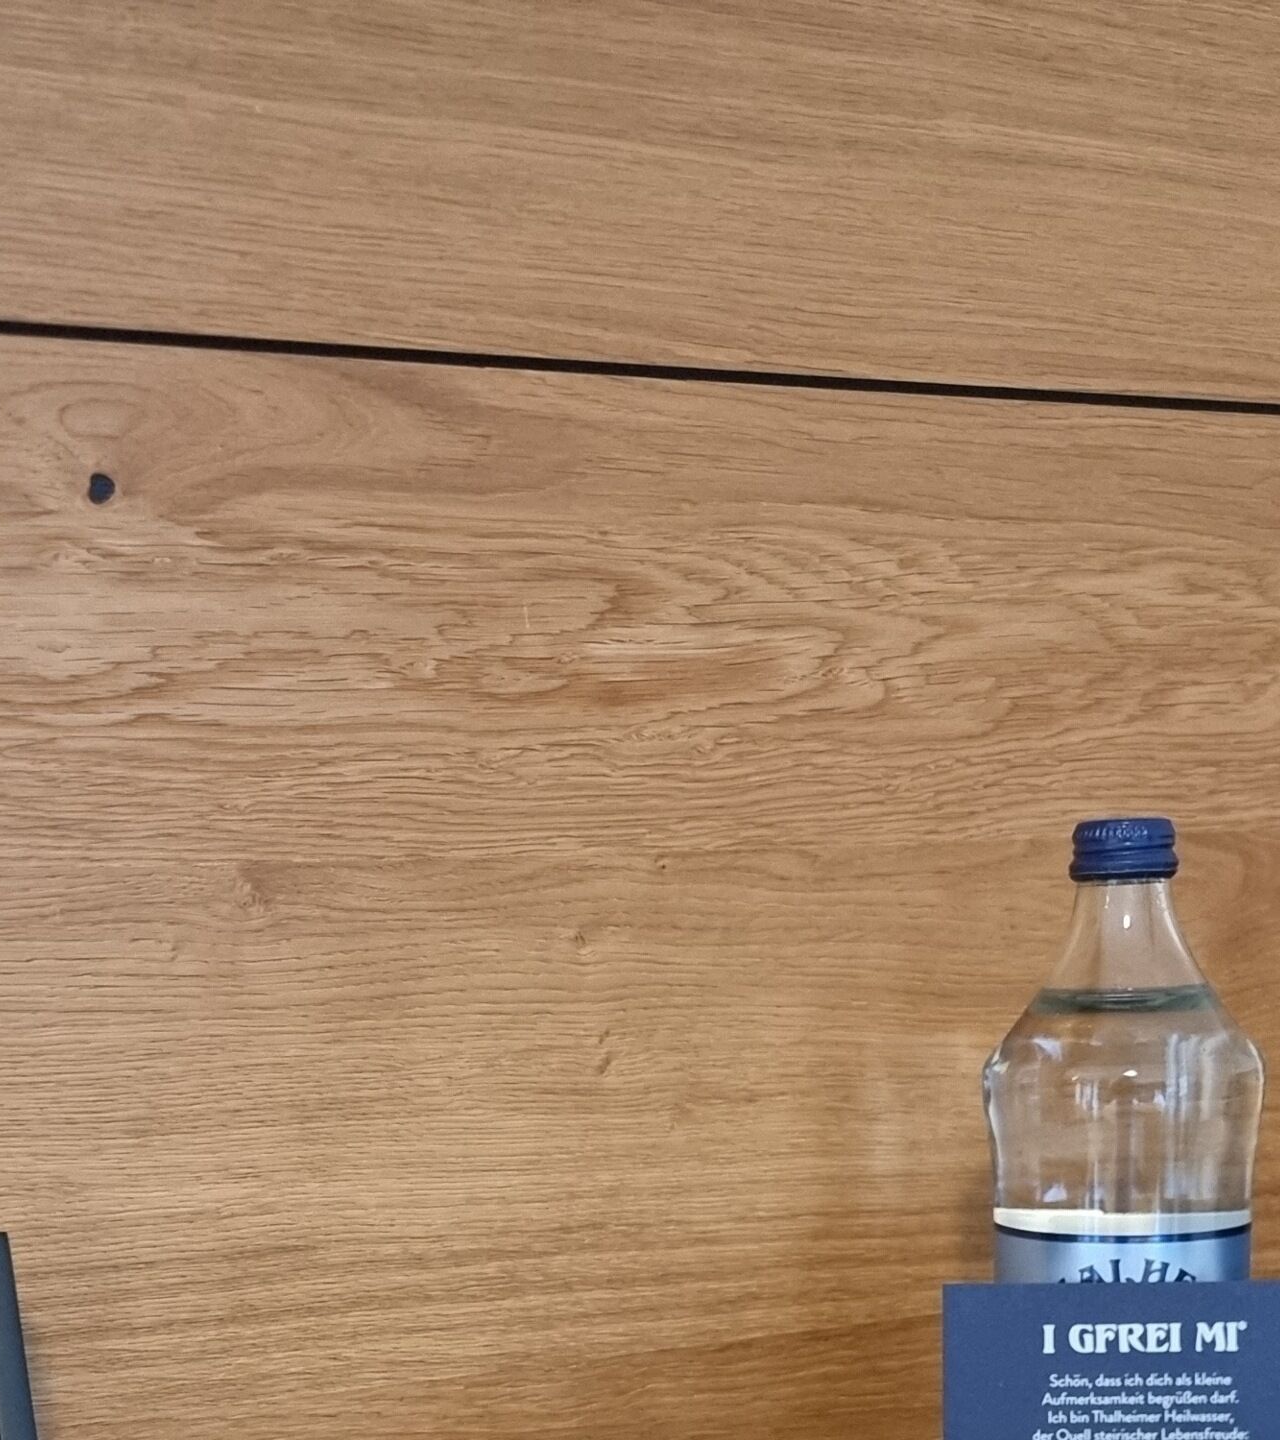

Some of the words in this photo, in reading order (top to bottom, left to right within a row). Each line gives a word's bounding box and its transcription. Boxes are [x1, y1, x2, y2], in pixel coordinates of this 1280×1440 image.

[1042, 1324, 1055, 1354] I
[1069, 1322, 1182, 1353] GFREI
[1049, 1373, 1093, 1389] Schön,
[1095, 1373, 1122, 1387] dass
[1124, 1373, 1143, 1387] ich
[1145, 1373, 1173, 1387] dich
[1175, 1372, 1192, 1386] als
[1194, 1372, 1233, 1386] kleine
[1042, 1390, 1145, 1406] Aufmerksamkeit
[1147, 1390, 1207, 1409] begrüßen
[1209, 1389, 1240, 1404] darf.
[1048, 1410, 1067, 1423] Ich
[1070, 1410, 1089, 1423] bin
[1092, 1409, 1162, 1423] Thalheimer
[1164, 1409, 1235, 1424] Heilwasser,
